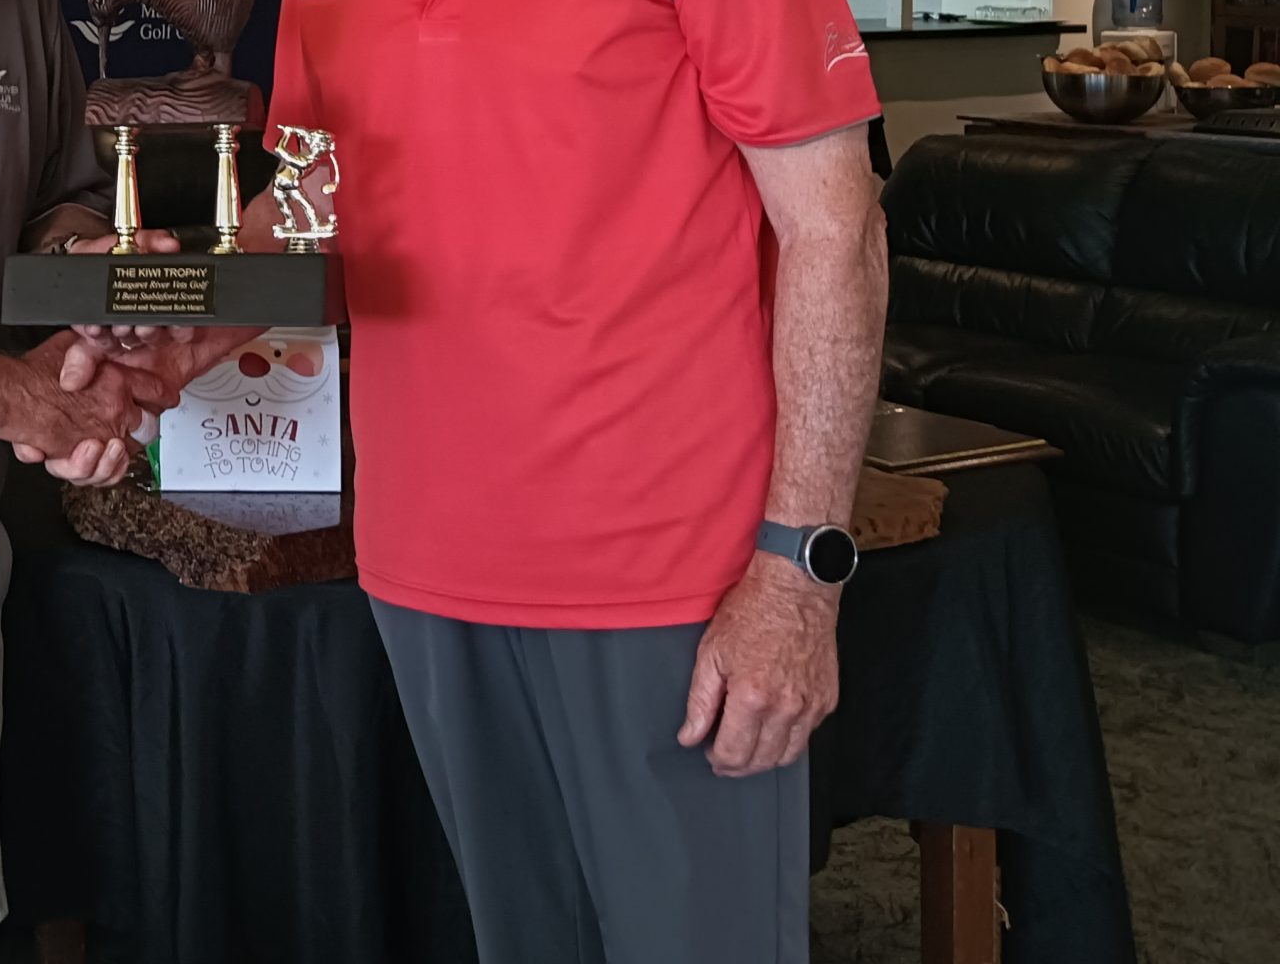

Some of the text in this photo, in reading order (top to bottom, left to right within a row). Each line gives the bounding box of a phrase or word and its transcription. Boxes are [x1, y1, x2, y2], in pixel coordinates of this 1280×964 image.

[139, 24, 173, 40] Golf
[115, 267, 208, 278] THE KIWI TROPHY
[112, 280, 148, 291] Margaret
[149, 280, 170, 290] River
[189, 280, 209, 291] Golf
[200, 412, 298, 443] SANTA
[204, 438, 302, 463] IS COMING
[203, 456, 299, 482] TO TOWN
